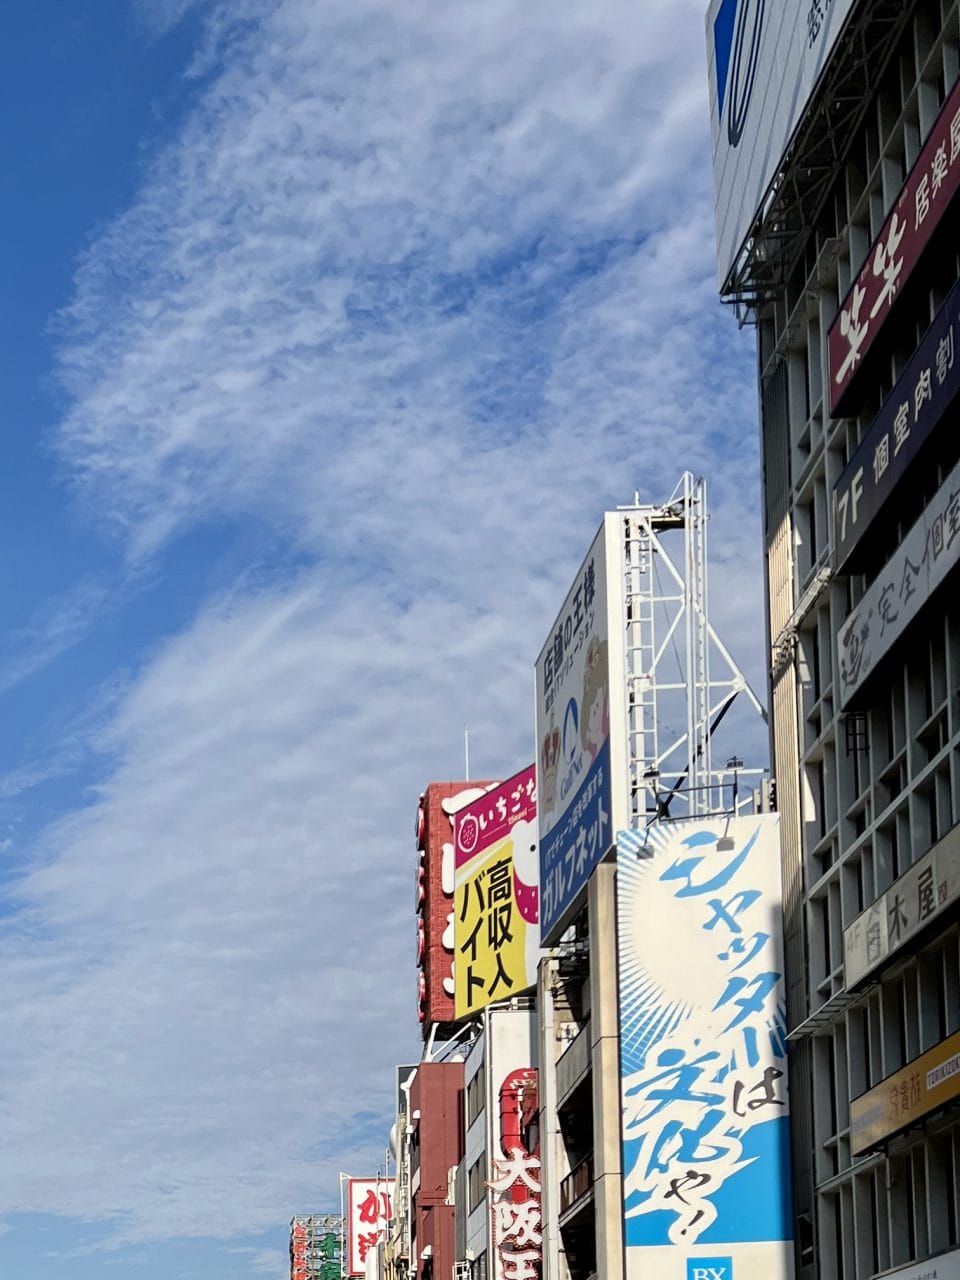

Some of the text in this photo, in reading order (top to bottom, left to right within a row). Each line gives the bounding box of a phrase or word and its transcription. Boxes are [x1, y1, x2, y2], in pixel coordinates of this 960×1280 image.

[838, 465, 864, 542] 7F
[544, 557, 595, 696] 店舗の王様
[487, 856, 514, 997] 高収入
[543, 797, 608, 926] ガルフネット
[460, 870, 486, 1008] バイト
